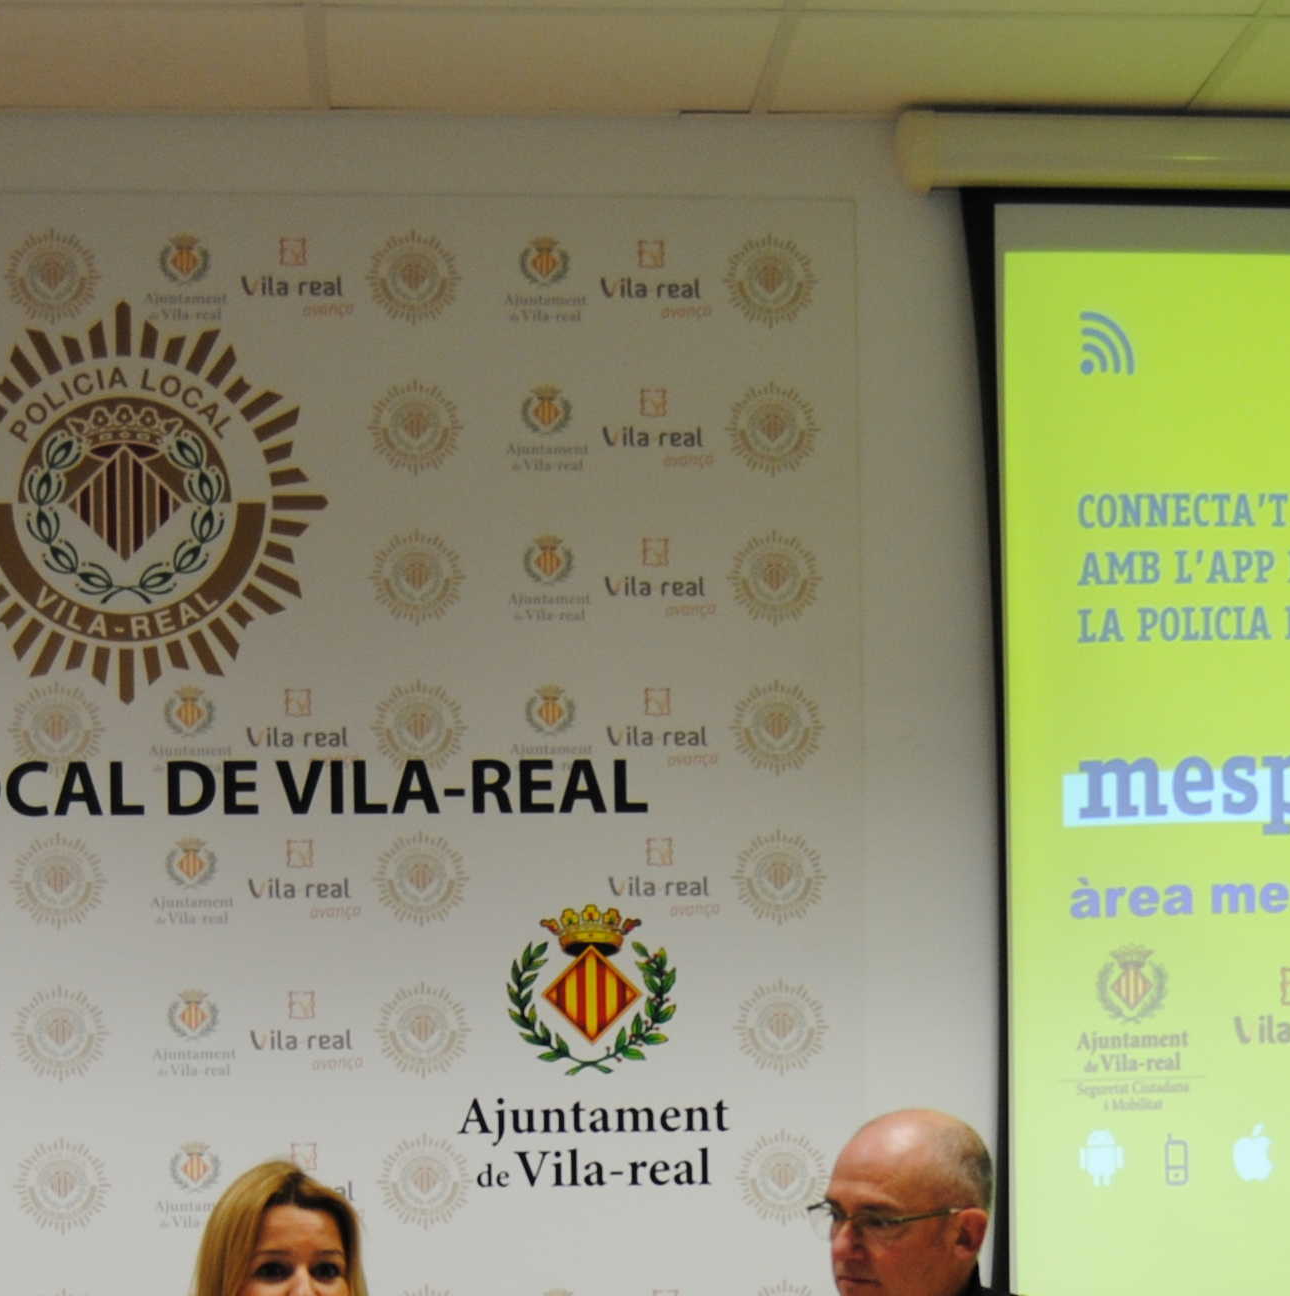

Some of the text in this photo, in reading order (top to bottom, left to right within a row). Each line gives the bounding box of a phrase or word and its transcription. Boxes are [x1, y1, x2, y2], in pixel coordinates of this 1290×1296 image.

[9, 365, 242, 444] POLICIA LOCAL
[1077, 492, 1289, 528] CONNECTA'T
[1077, 551, 1161, 585] AMB
[1174, 549, 1275, 584] L'APP
[32, 587, 219, 638] VILA-REAL
[1077, 608, 1124, 643] LA
[1136, 606, 1270, 642] POLICIA
[166, 758, 260, 817] DE
[274, 757, 649, 816] VILA-REAL
[1069, 878, 1194, 919] àrea
[1076, 1029, 1189, 1054] Ajuntament
[1101, 1052, 1181, 1073] Vila-real
[457, 1096, 729, 1143] Ajuntament
[475, 1147, 711, 1189] de Vila-real
